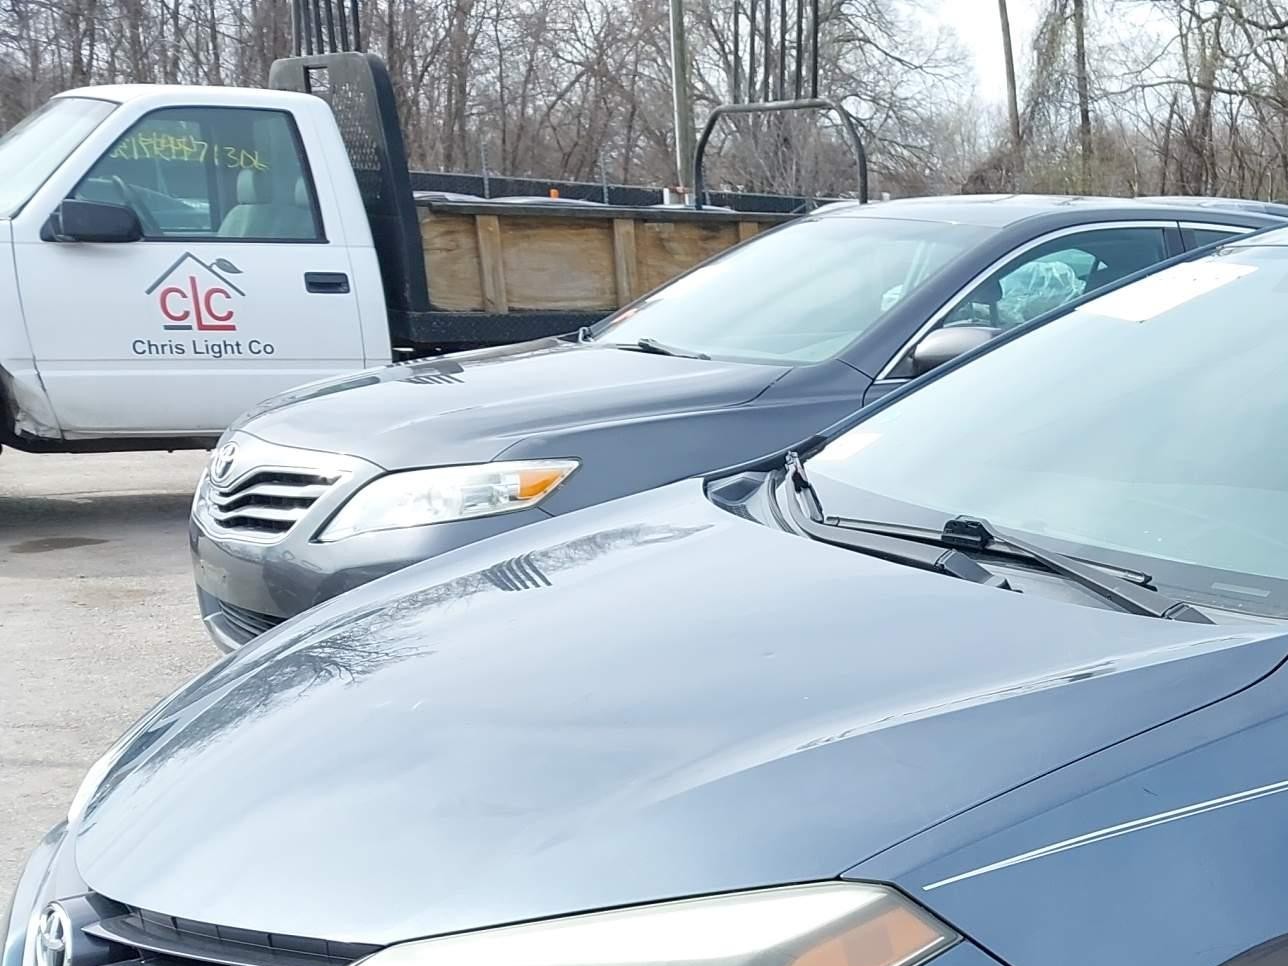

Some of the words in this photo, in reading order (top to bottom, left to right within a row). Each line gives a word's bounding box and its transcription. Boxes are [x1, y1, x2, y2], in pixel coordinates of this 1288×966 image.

[160, 276, 236, 331] CLC
[132, 339, 185, 355] Chris
[192, 339, 243, 358] Light
[248, 339, 275, 355] Co
